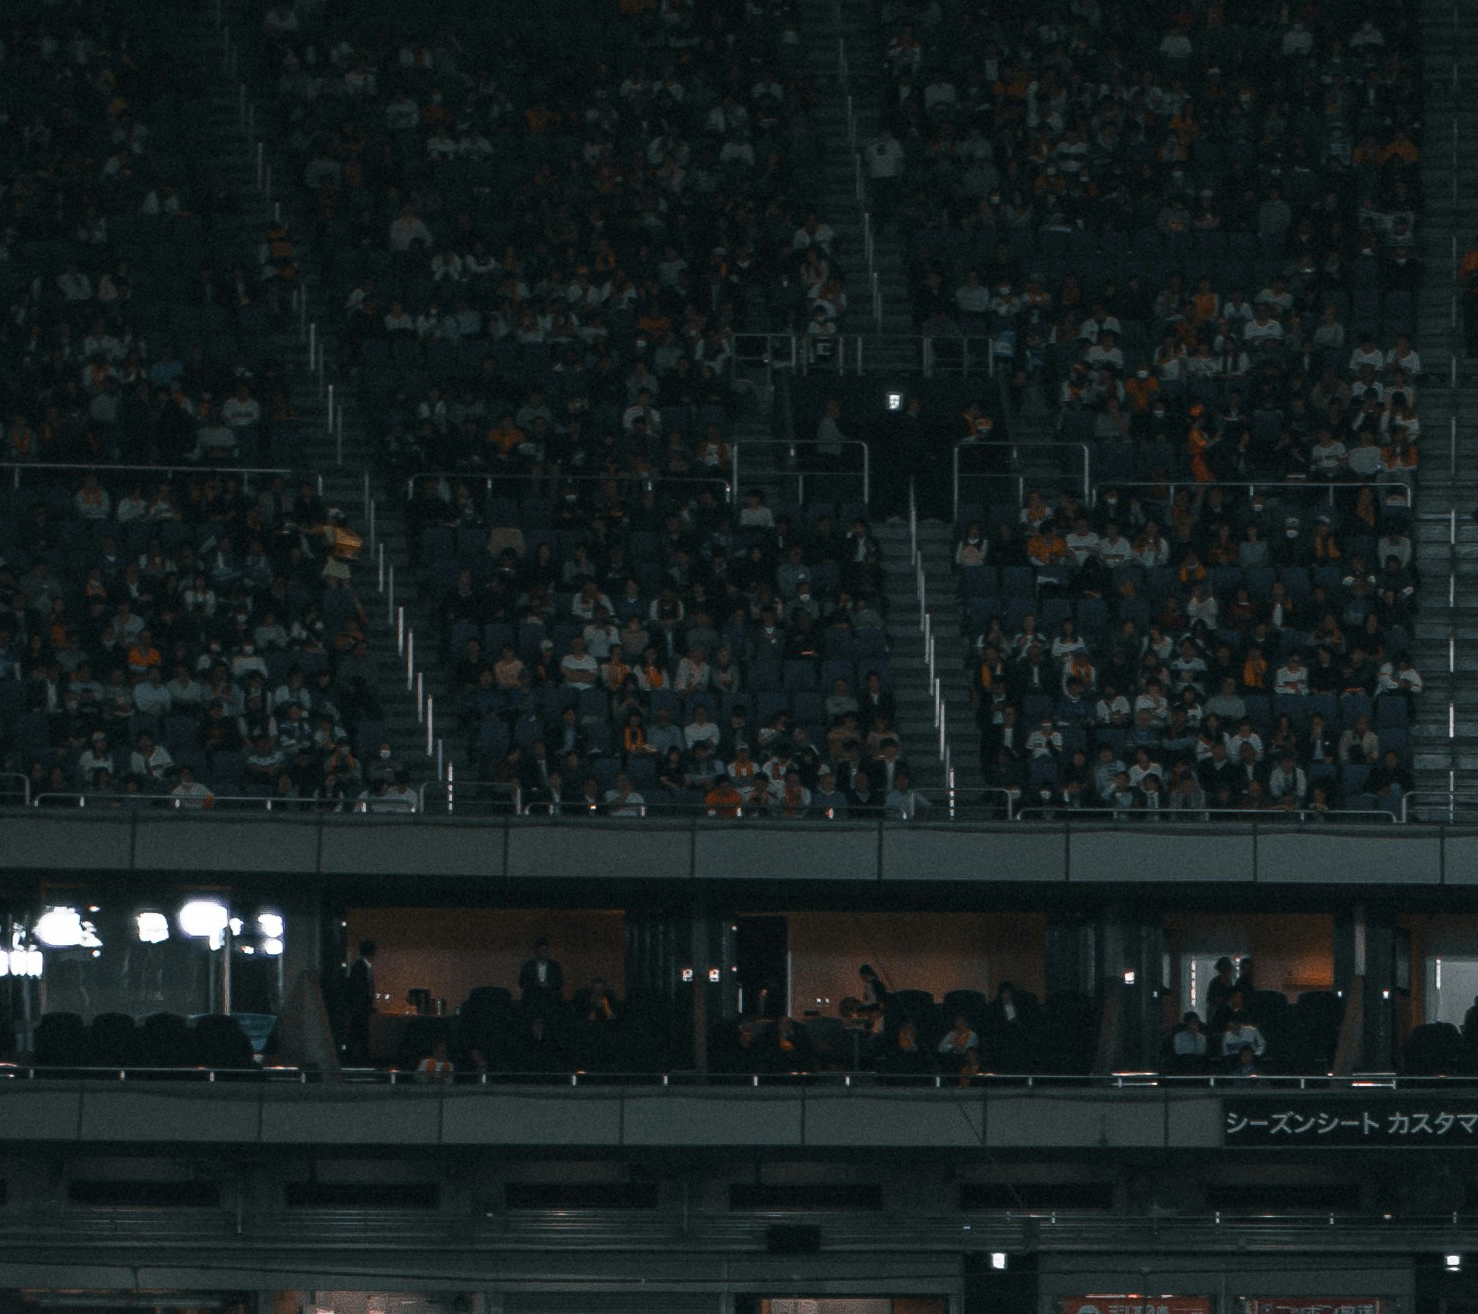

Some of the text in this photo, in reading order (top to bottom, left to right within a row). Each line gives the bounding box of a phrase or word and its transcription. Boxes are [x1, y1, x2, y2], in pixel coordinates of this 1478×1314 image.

[1226, 1111, 1380, 1135] シーズンシート
